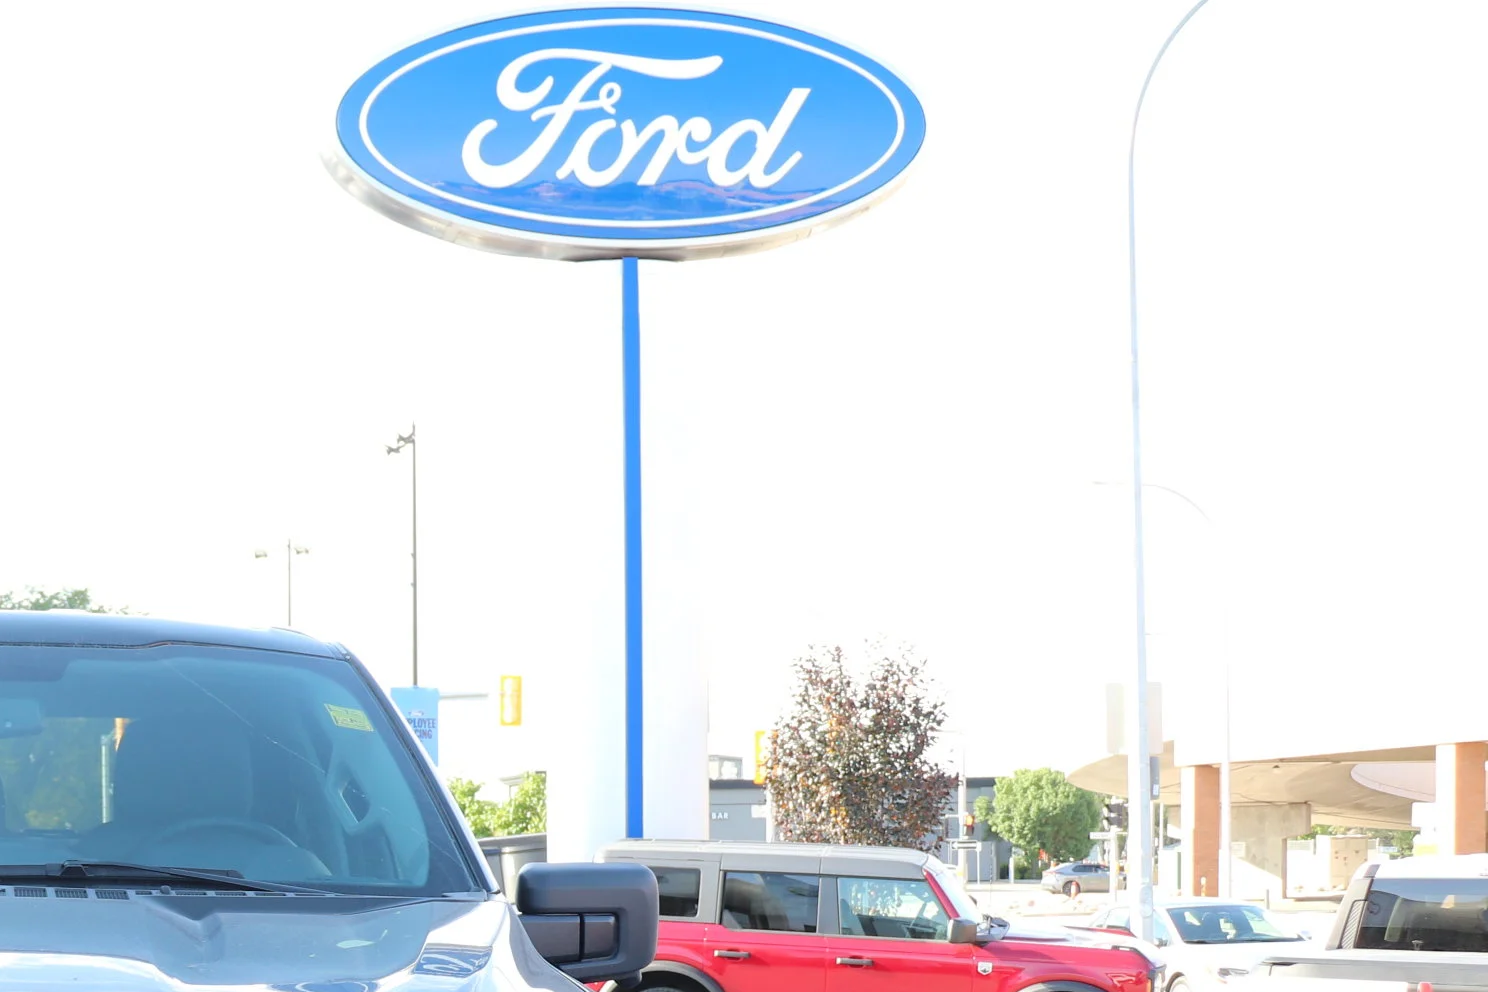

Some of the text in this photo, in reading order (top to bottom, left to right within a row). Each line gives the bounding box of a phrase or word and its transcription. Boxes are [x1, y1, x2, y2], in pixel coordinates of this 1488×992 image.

[462, 47, 811, 189] Ford
[407, 718, 436, 728] PLOYEE
[415, 728, 432, 739] CING
[711, 811, 729, 820] BAR
